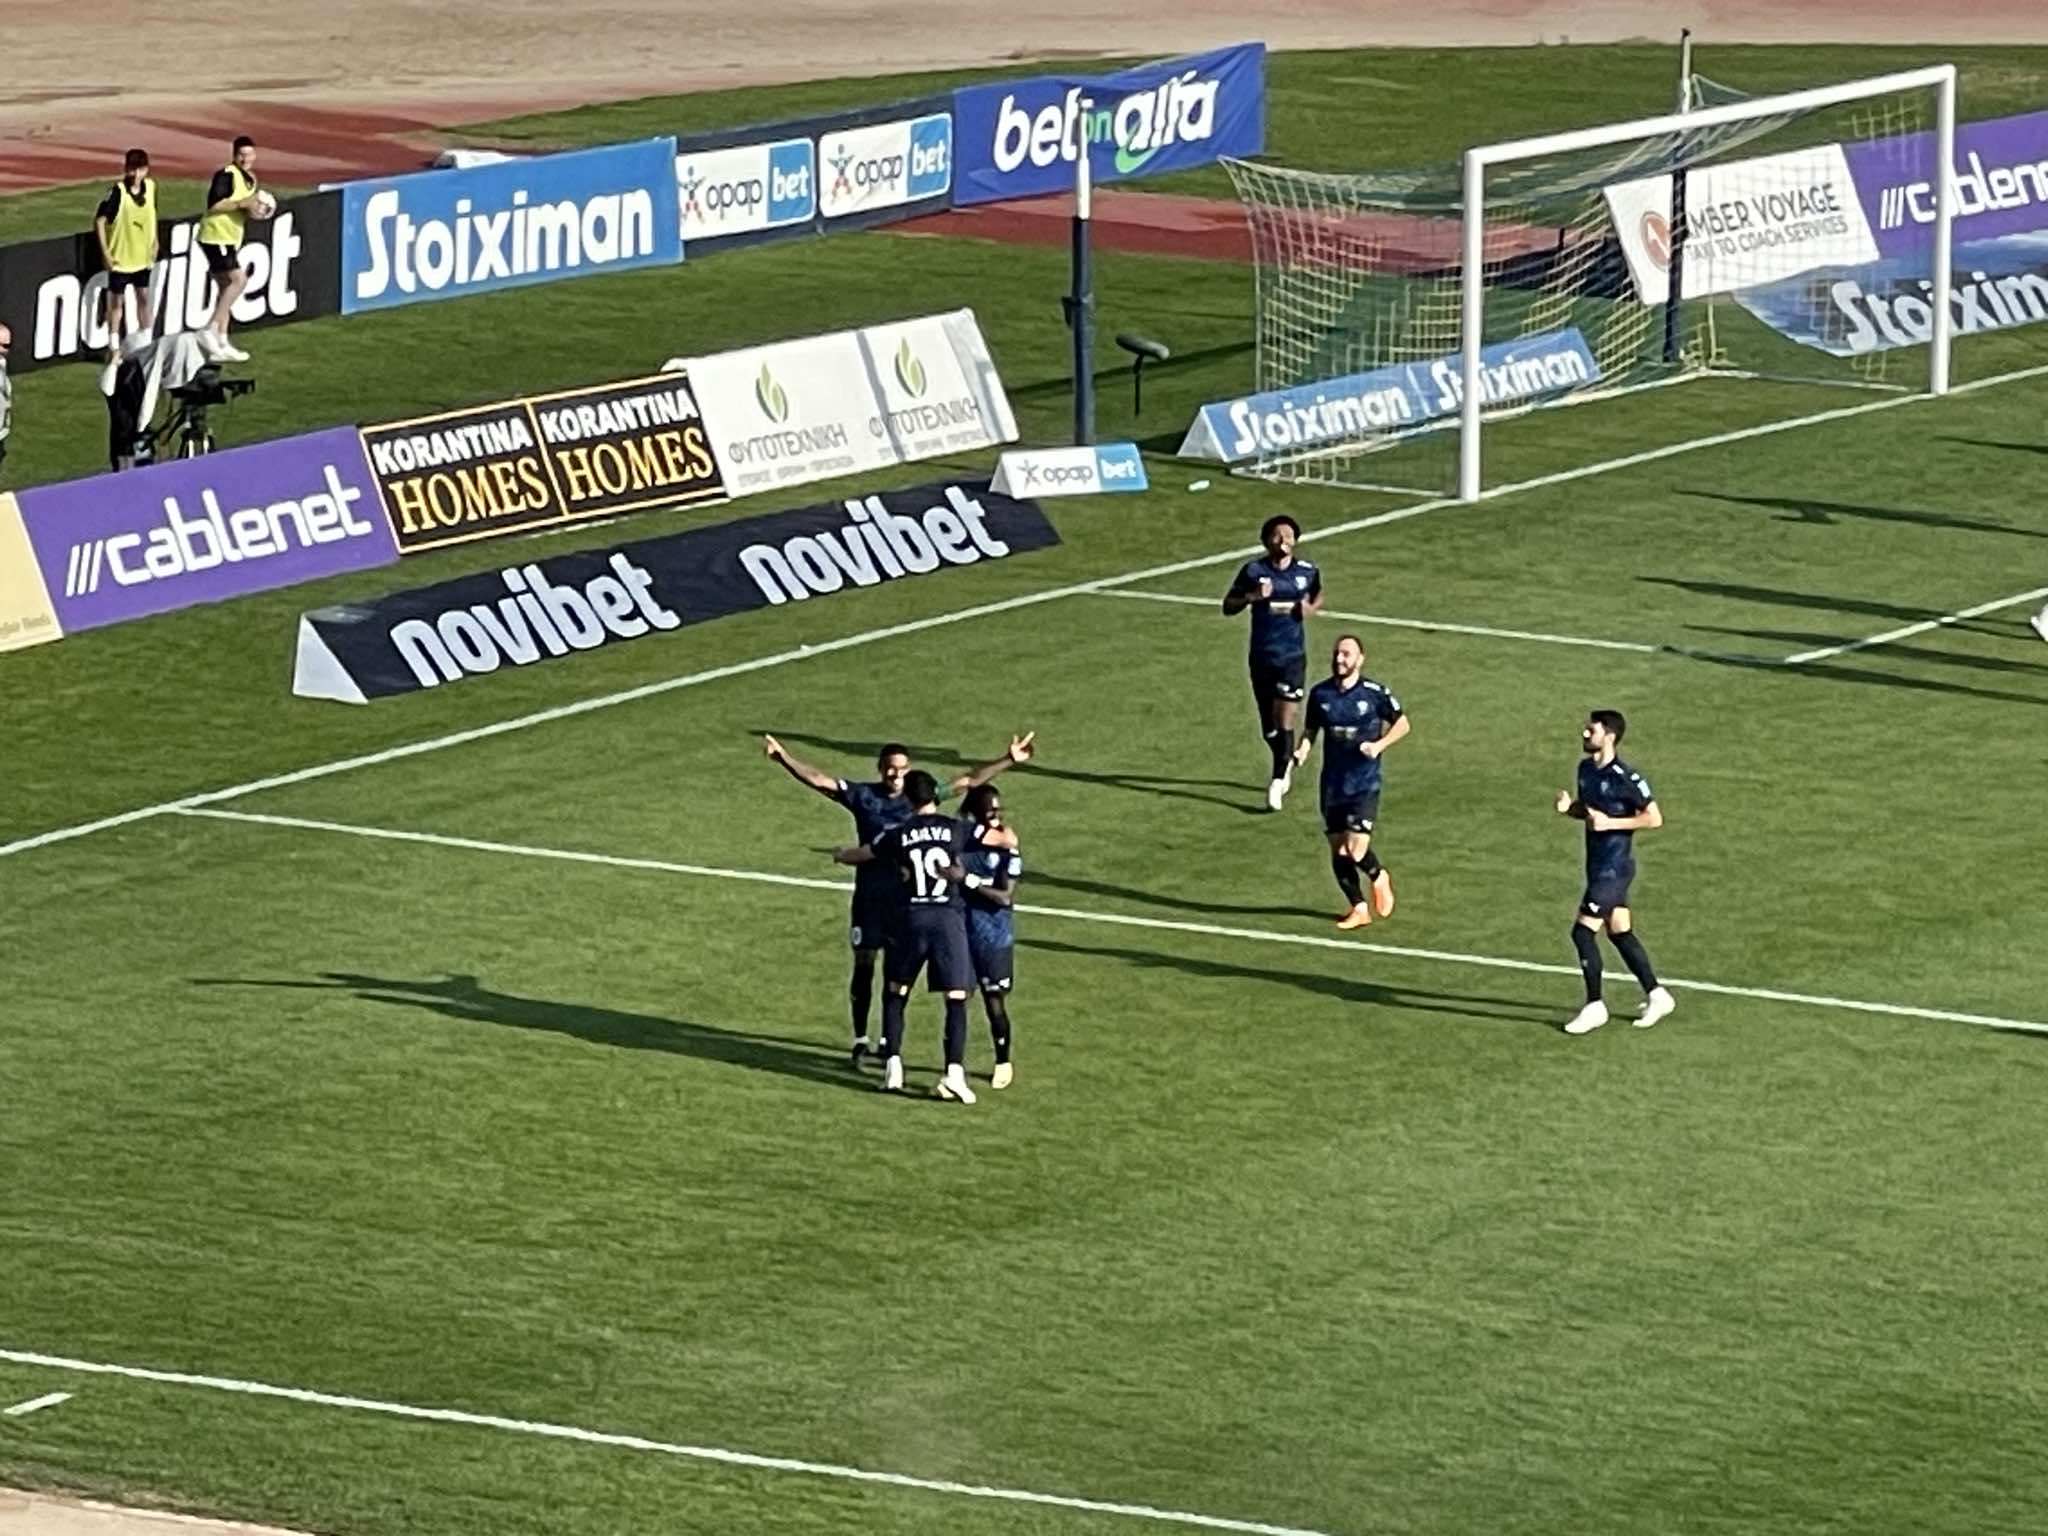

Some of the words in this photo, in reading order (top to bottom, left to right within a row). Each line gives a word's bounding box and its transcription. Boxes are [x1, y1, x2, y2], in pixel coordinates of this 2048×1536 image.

[705, 179, 763, 220] opap
[772, 165, 809, 201] bet
[855, 154, 903, 192] opap
[912, 139, 946, 177] bet
[1687, 201, 1754, 239] MBER
[1752, 183, 1841, 226] VOYAGE
[1715, 236, 1737, 256] TO
[1738, 229, 1786, 253] COACH
[1786, 215, 1848, 243] SERVICES
[357, 189, 653, 298] Stoiximan
[1431, 350, 1588, 410] Stiximan
[539, 388, 699, 443] KORANTINA
[1230, 386, 1411, 454] Stoiximan
[372, 417, 534, 476] KORANTINA
[556, 427, 714, 501] HOMES
[1043, 465, 1093, 486] opap
[1100, 458, 1136, 480] bet
[389, 457, 550, 534] HOMES
[106, 465, 373, 587] cablenet
[738, 485, 1010, 605] novibet
[390, 553, 681, 688] novibet
[909, 847, 951, 896] 19
